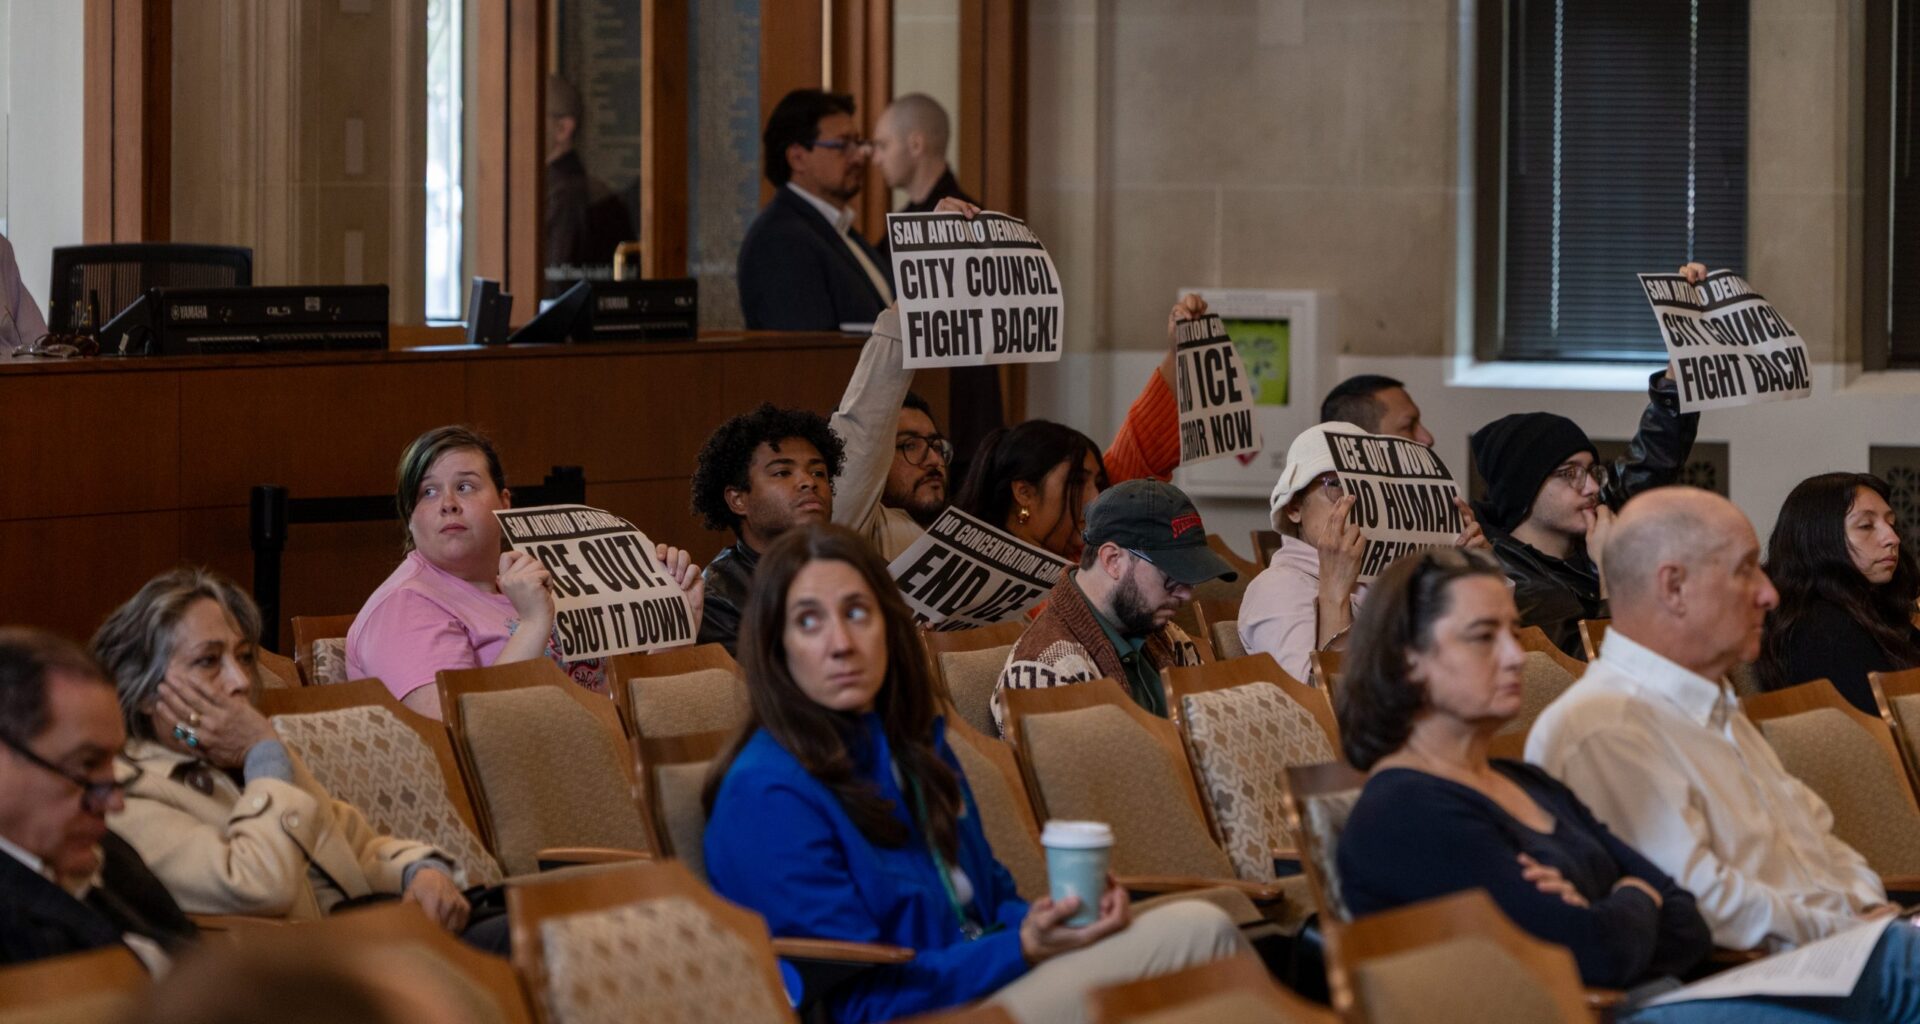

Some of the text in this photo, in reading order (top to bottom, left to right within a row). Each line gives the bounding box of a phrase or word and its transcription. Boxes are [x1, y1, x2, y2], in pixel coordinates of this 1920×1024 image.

[893, 221, 924, 245] SAN
[927, 219, 985, 243] ANTONIO
[900, 255, 1058, 300] CITY COUNCIL
[1646, 279, 1673, 301] SAN
[907, 306, 1058, 358] FIGHT BACK!
[1662, 305, 1796, 348] CITY COUNCIL
[1193, 346, 1242, 408] ICE
[1678, 346, 1809, 403] FIGHT BACK!
[1210, 409, 1252, 454] NOW
[1333, 435, 1443, 476] ICE OUT NOW!
[505, 516, 532, 538] SAN
[527, 513, 575, 537] ANTONIO
[1344, 477, 1462, 534] NO HUMAN
[578, 534, 668, 593] OUT!
[934, 514, 961, 536] NO
[954, 523, 1043, 578] CONCENTRATION
[895, 543, 1044, 623] END ICE
[557, 596, 691, 657] SHUT IT DOWN
